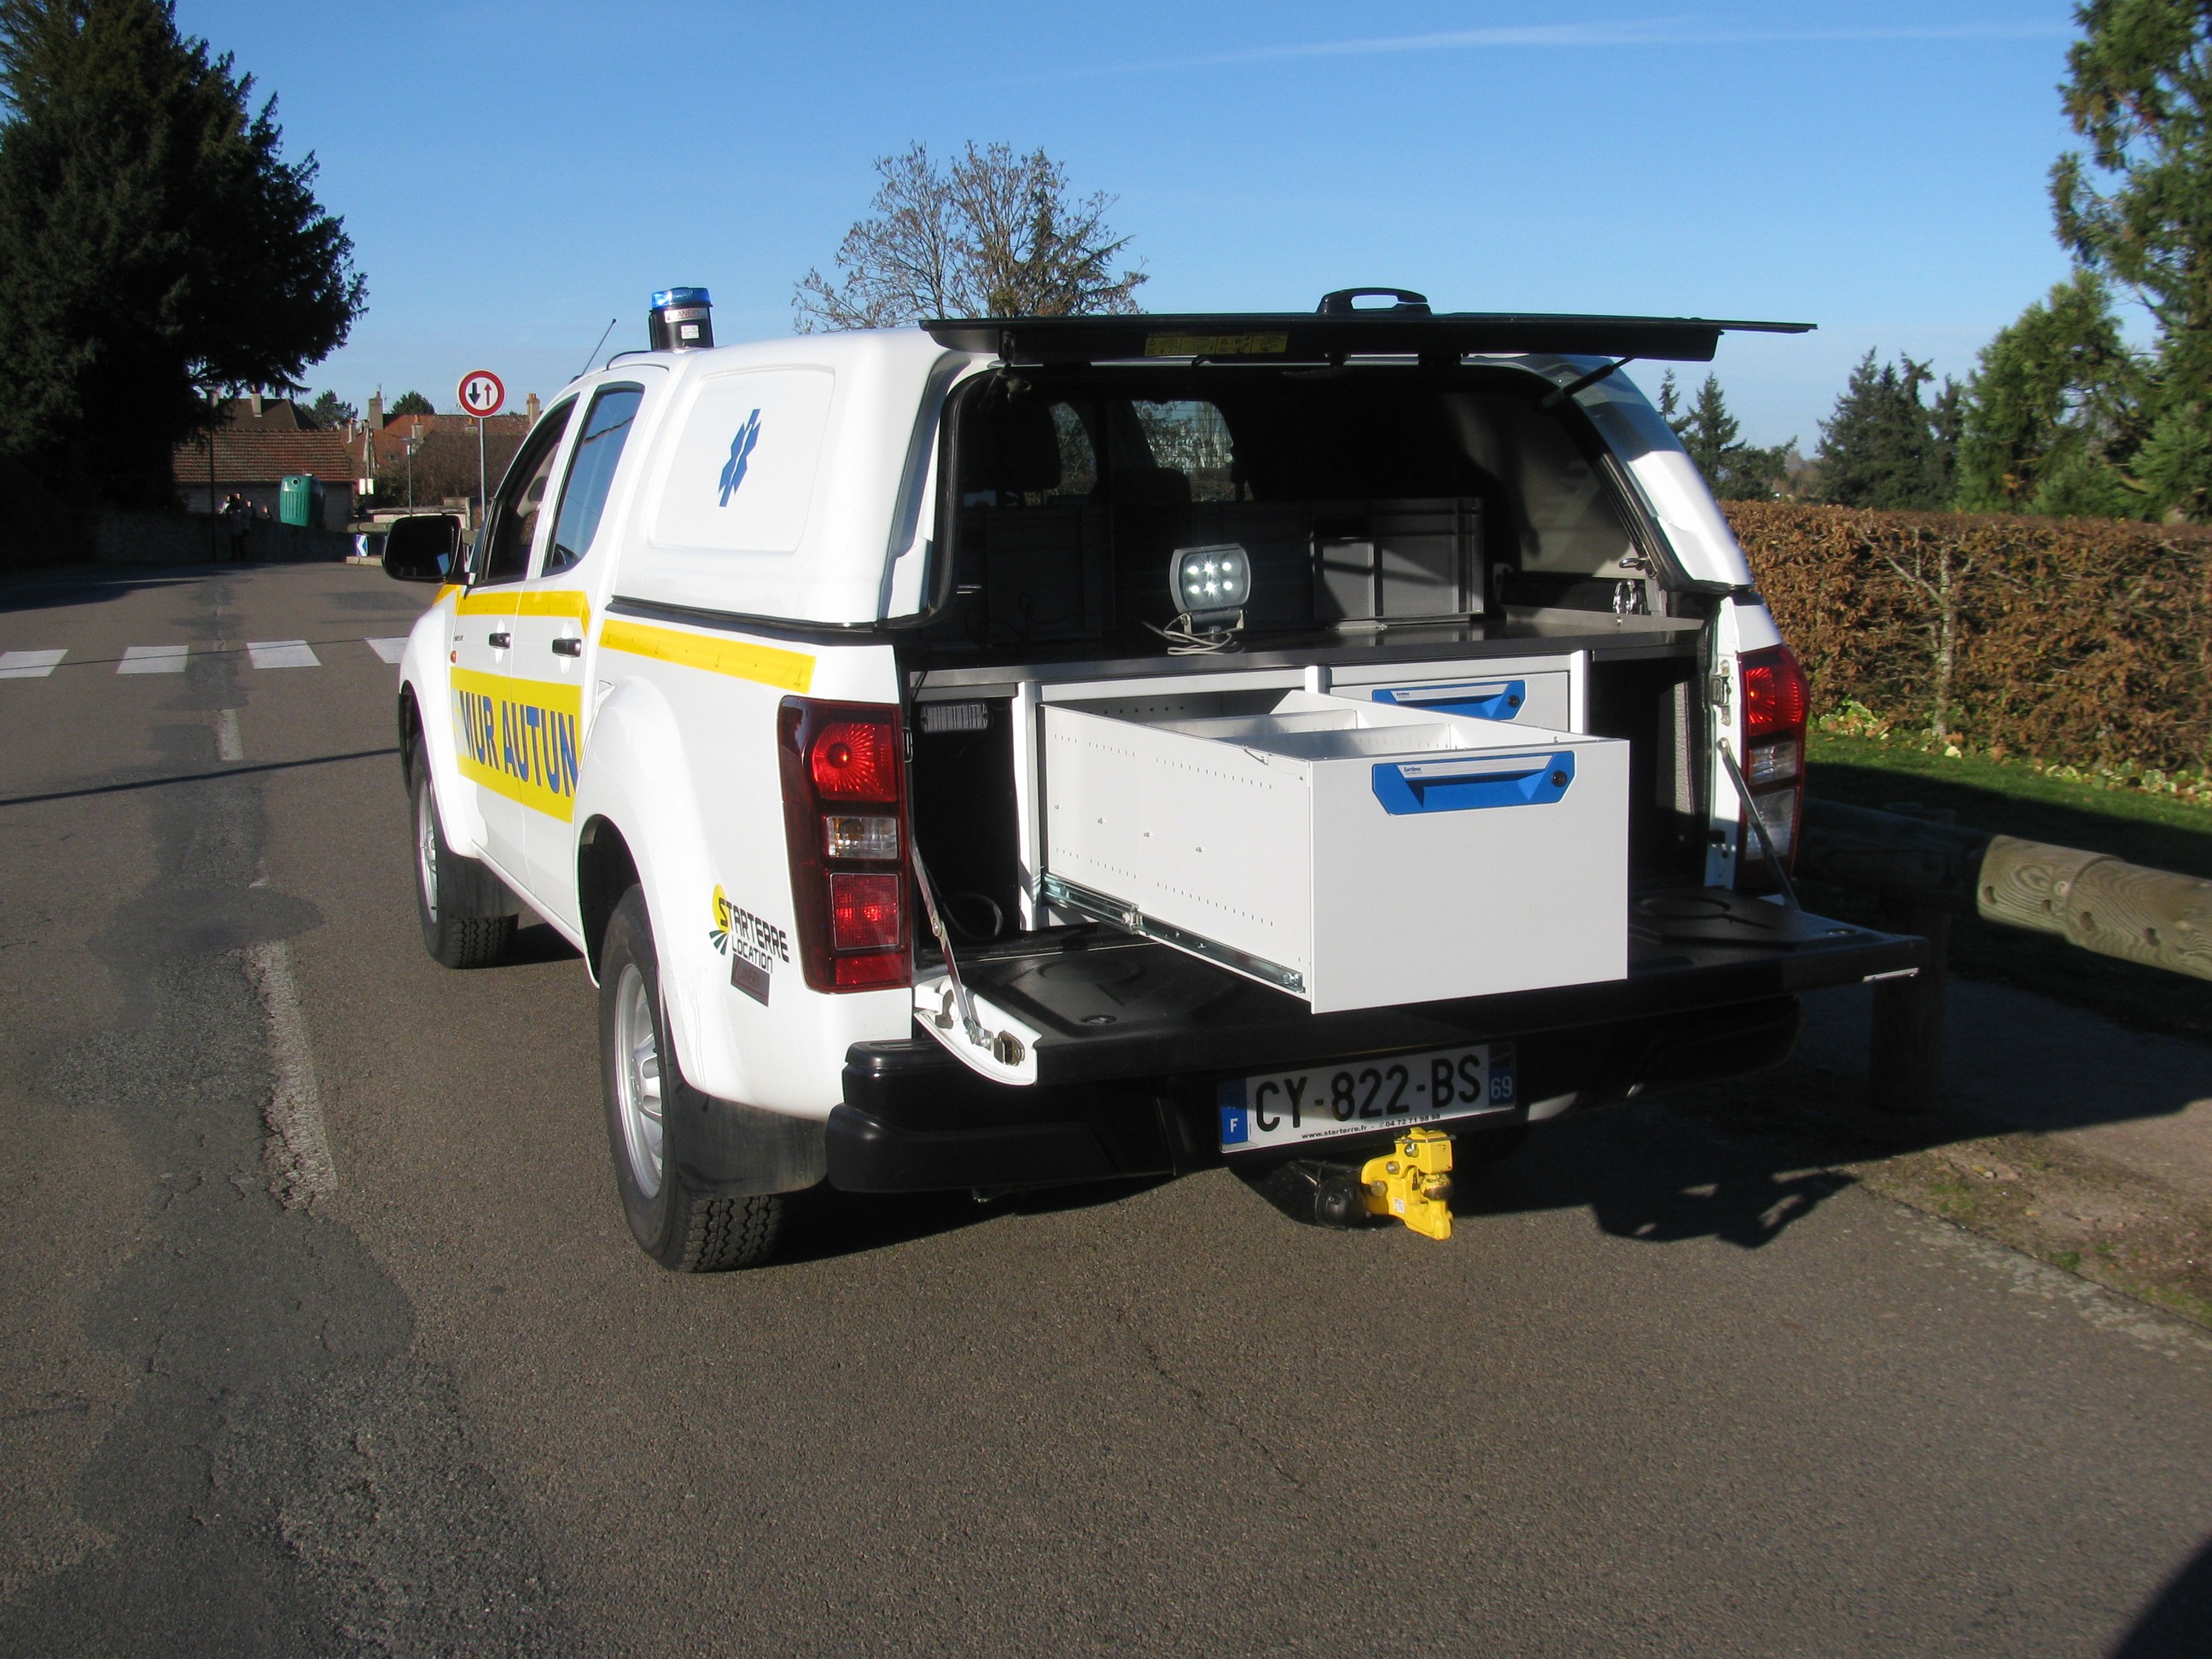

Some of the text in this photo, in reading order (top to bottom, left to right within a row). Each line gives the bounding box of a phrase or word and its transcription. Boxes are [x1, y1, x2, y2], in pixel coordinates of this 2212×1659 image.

[502, 700, 579, 798] AUTUN
[718, 896, 790, 964] STARTERRE
[1490, 1075, 1513, 1100] 69
[1230, 1118, 1238, 1133] F
[1301, 1125, 1367, 1139] www.starterre.fr
